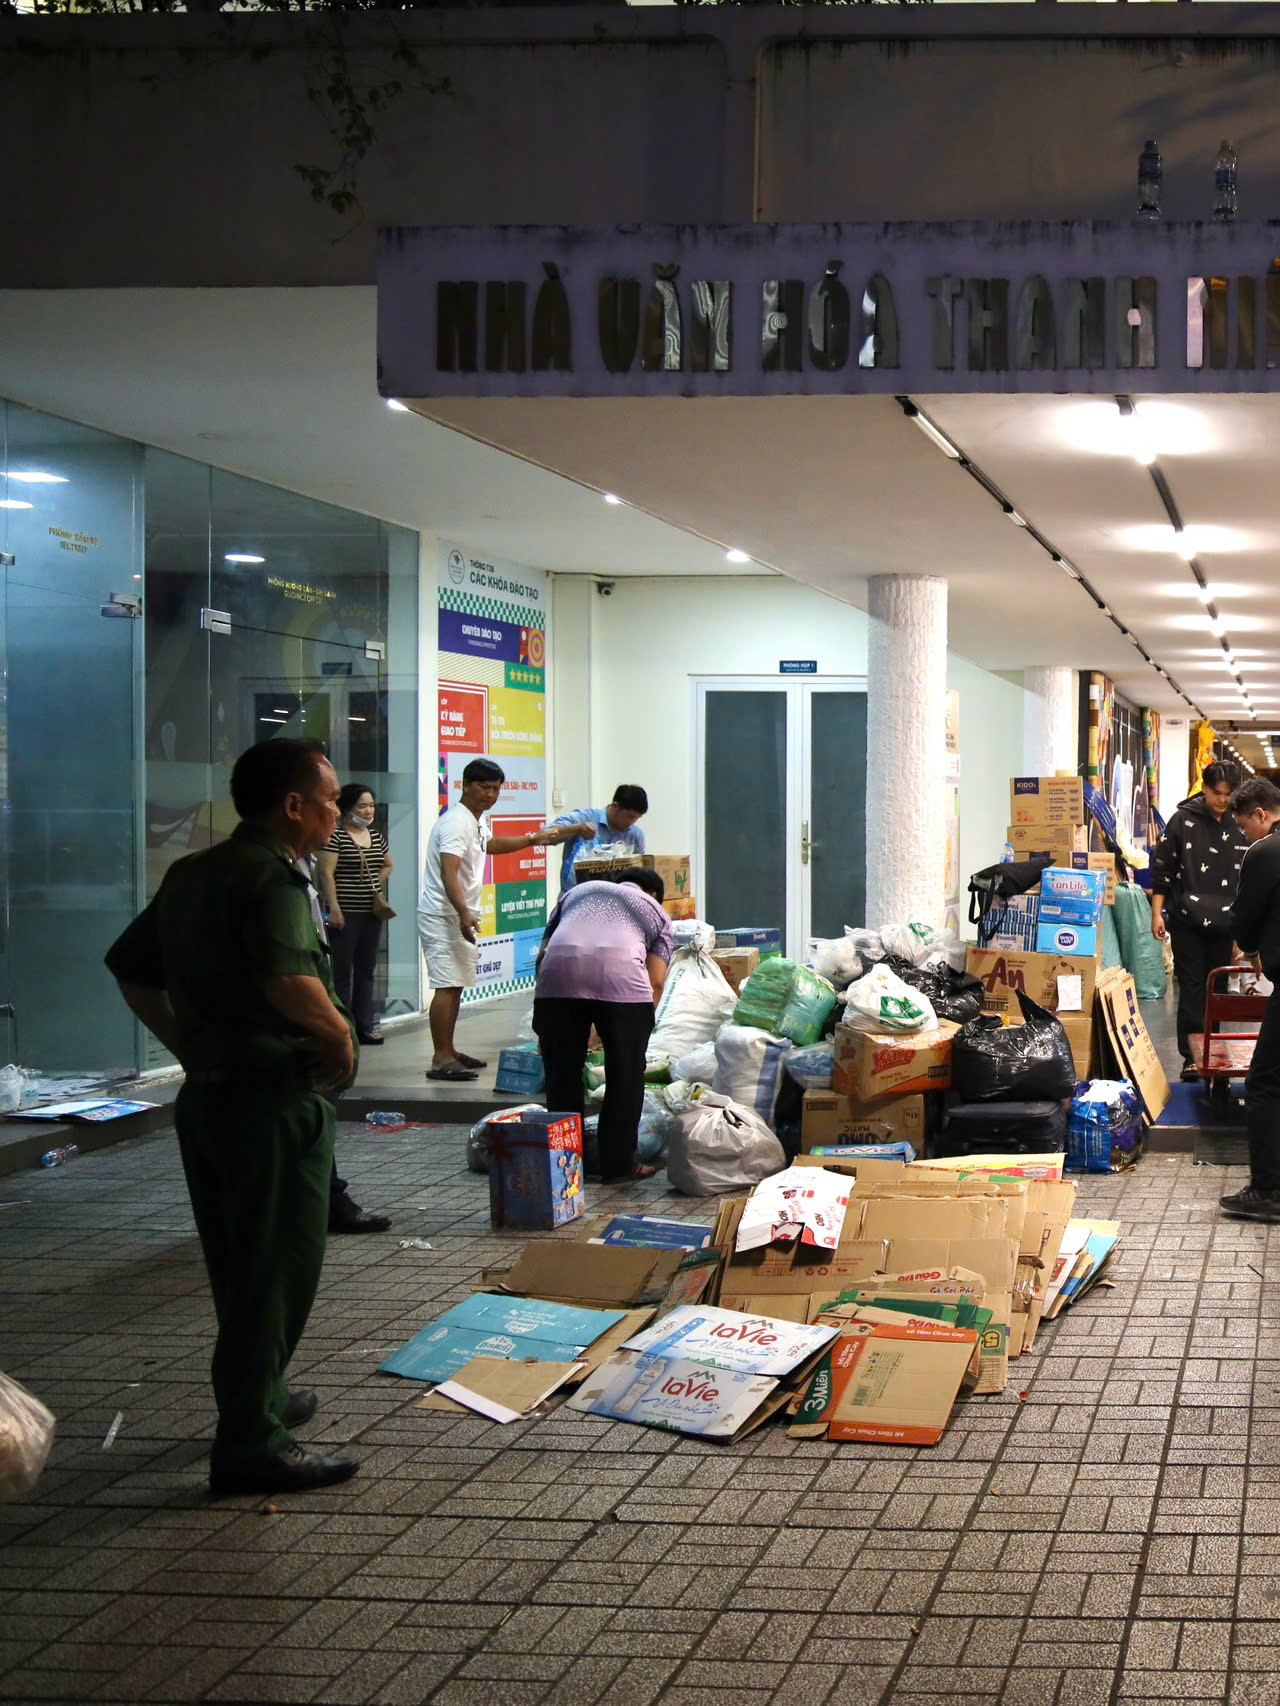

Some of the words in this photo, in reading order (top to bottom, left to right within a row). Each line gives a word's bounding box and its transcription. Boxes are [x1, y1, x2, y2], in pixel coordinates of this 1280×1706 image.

[437, 262, 571, 372] NHÀ
[599, 263, 731, 372] VĂN
[761, 259, 900, 372] HÓA
[927, 275, 1155, 371] THANH
[470, 570, 486, 586] CÁC
[488, 576, 508, 592] KHÓA
[510, 581, 524, 597] ĐÀO
[526, 586, 538, 602] TẠO
[710, 1322, 778, 1346] laVie
[661, 1376, 720, 1402] laVie
[804, 1369, 828, 1412] 3Miền
